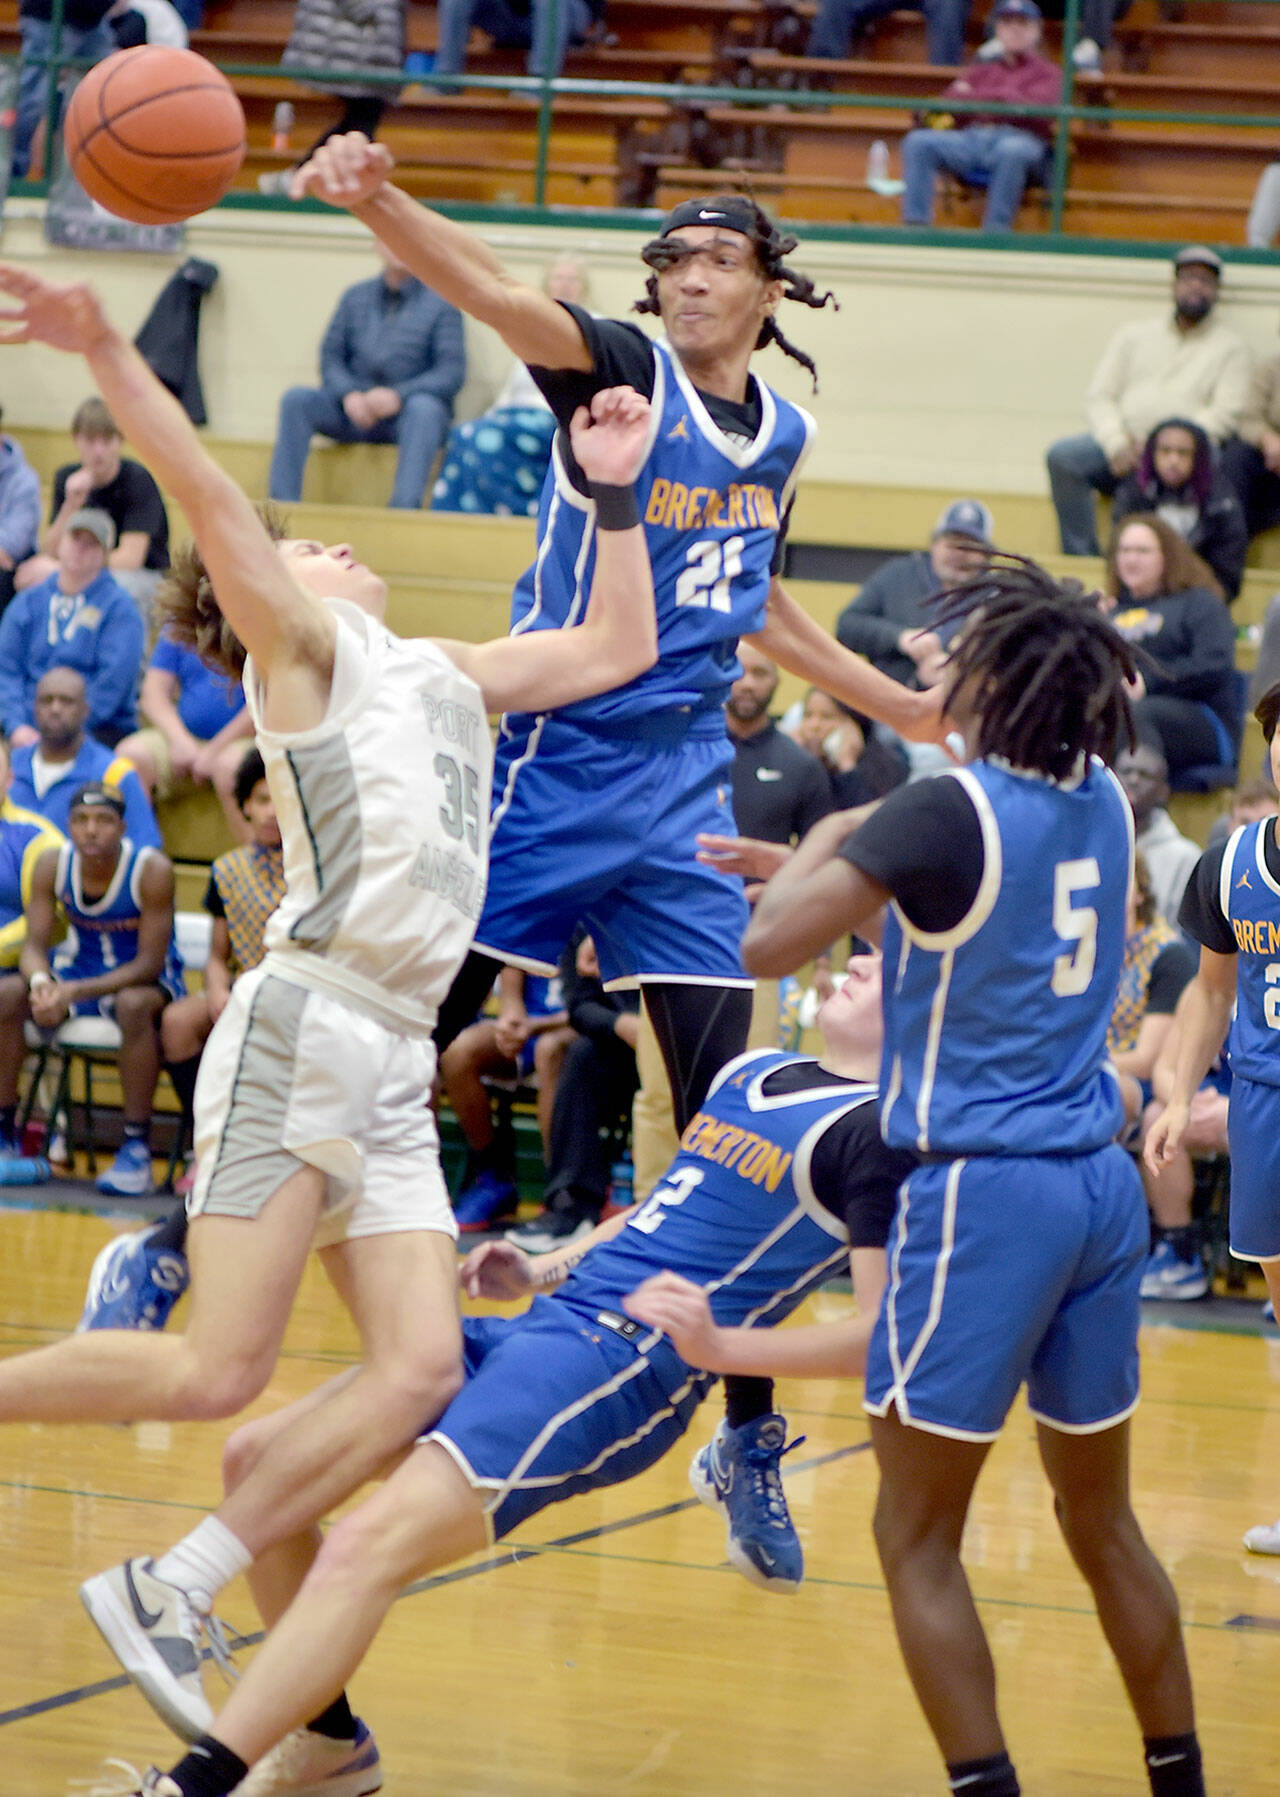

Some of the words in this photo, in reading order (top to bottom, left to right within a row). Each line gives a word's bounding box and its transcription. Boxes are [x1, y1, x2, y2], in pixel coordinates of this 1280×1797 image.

[675, 535, 745, 614] 21
[420, 692, 481, 760] PORT
[433, 752, 479, 857] 35
[1051, 857, 1101, 998] 5
[626, 1166, 705, 1234] 2
